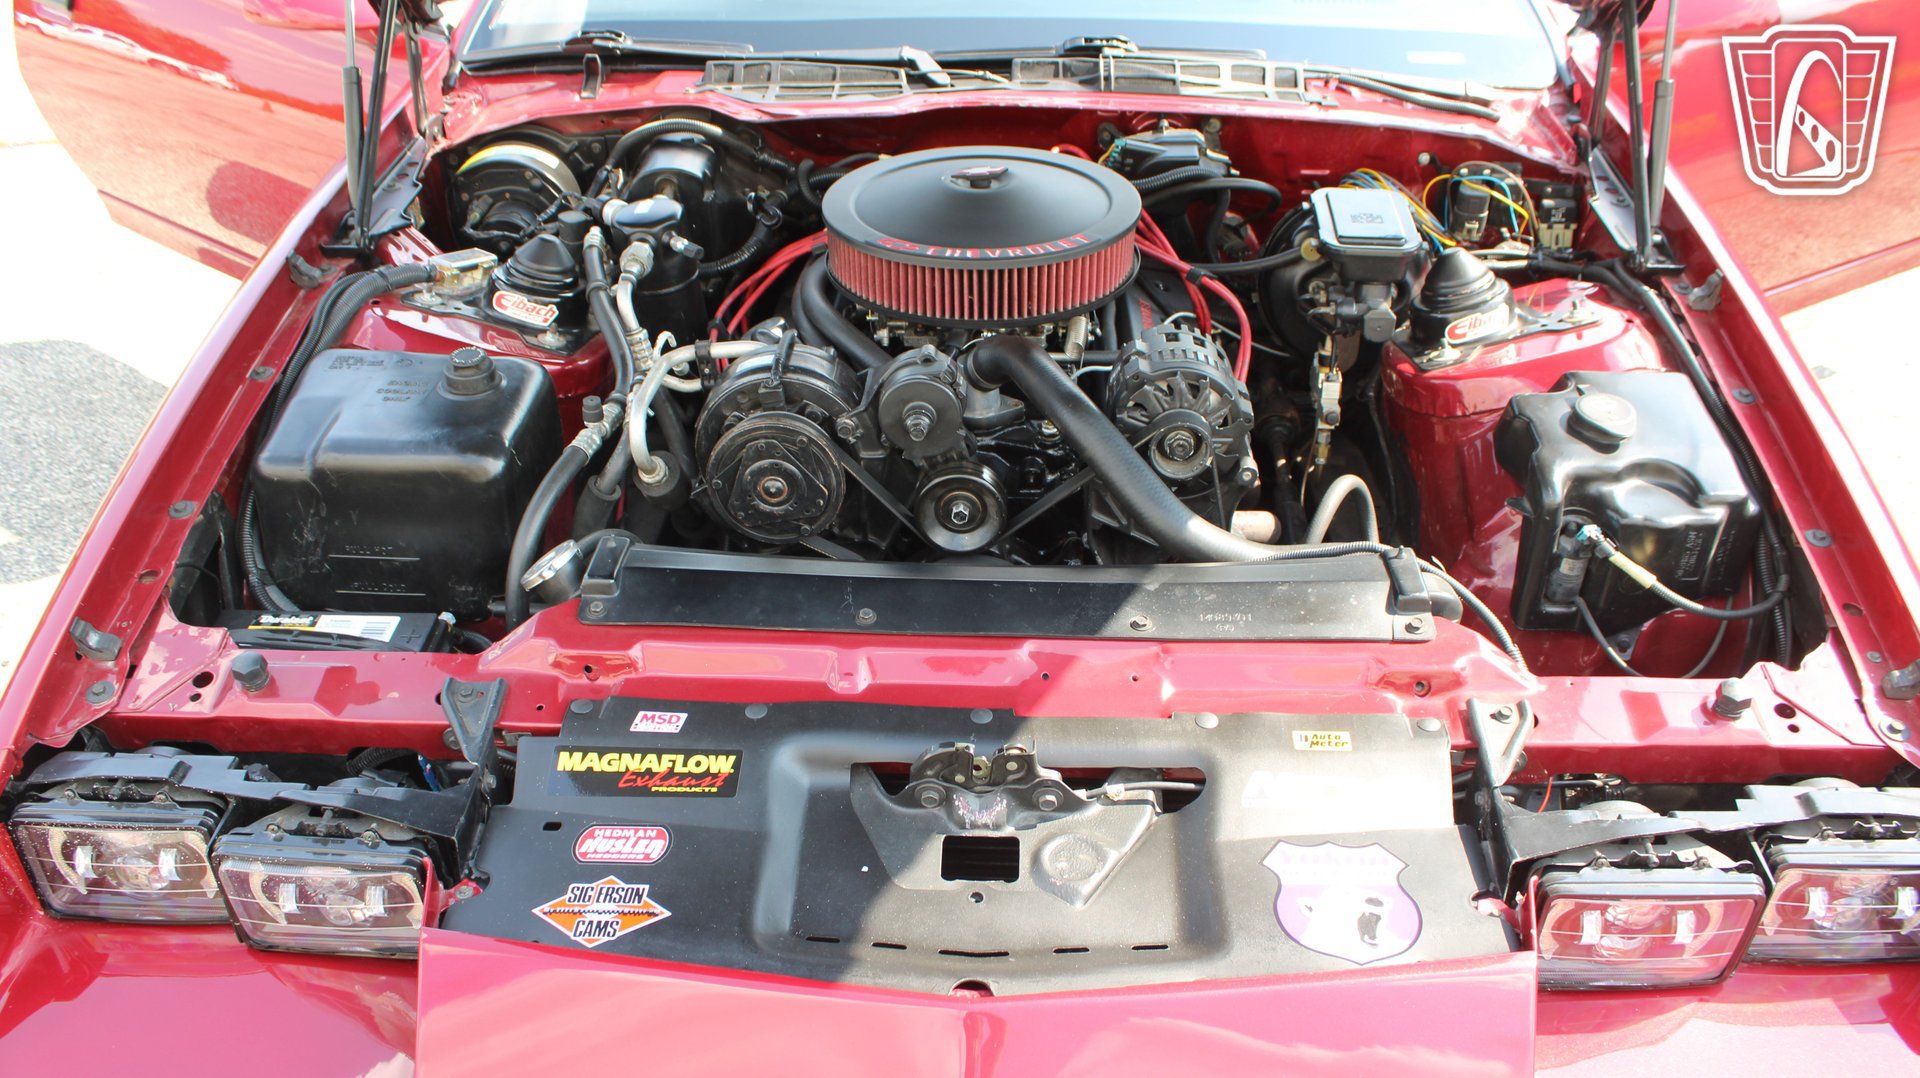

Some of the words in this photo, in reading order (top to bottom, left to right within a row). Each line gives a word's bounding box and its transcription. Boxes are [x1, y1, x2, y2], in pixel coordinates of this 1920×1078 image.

[925, 233, 1090, 258] CHEVROLET
[495, 293, 557, 318] Eibach
[259, 614, 314, 625] Duralast
[639, 713, 681, 725] MSD
[1309, 740, 1349, 748] Meter
[617, 768, 731, 788] Exhaust
[593, 829, 657, 838] HEDMAN
[567, 885, 595, 904] SIG
[595, 886, 646, 905] ERSON
[573, 919, 619, 938] CAMS
